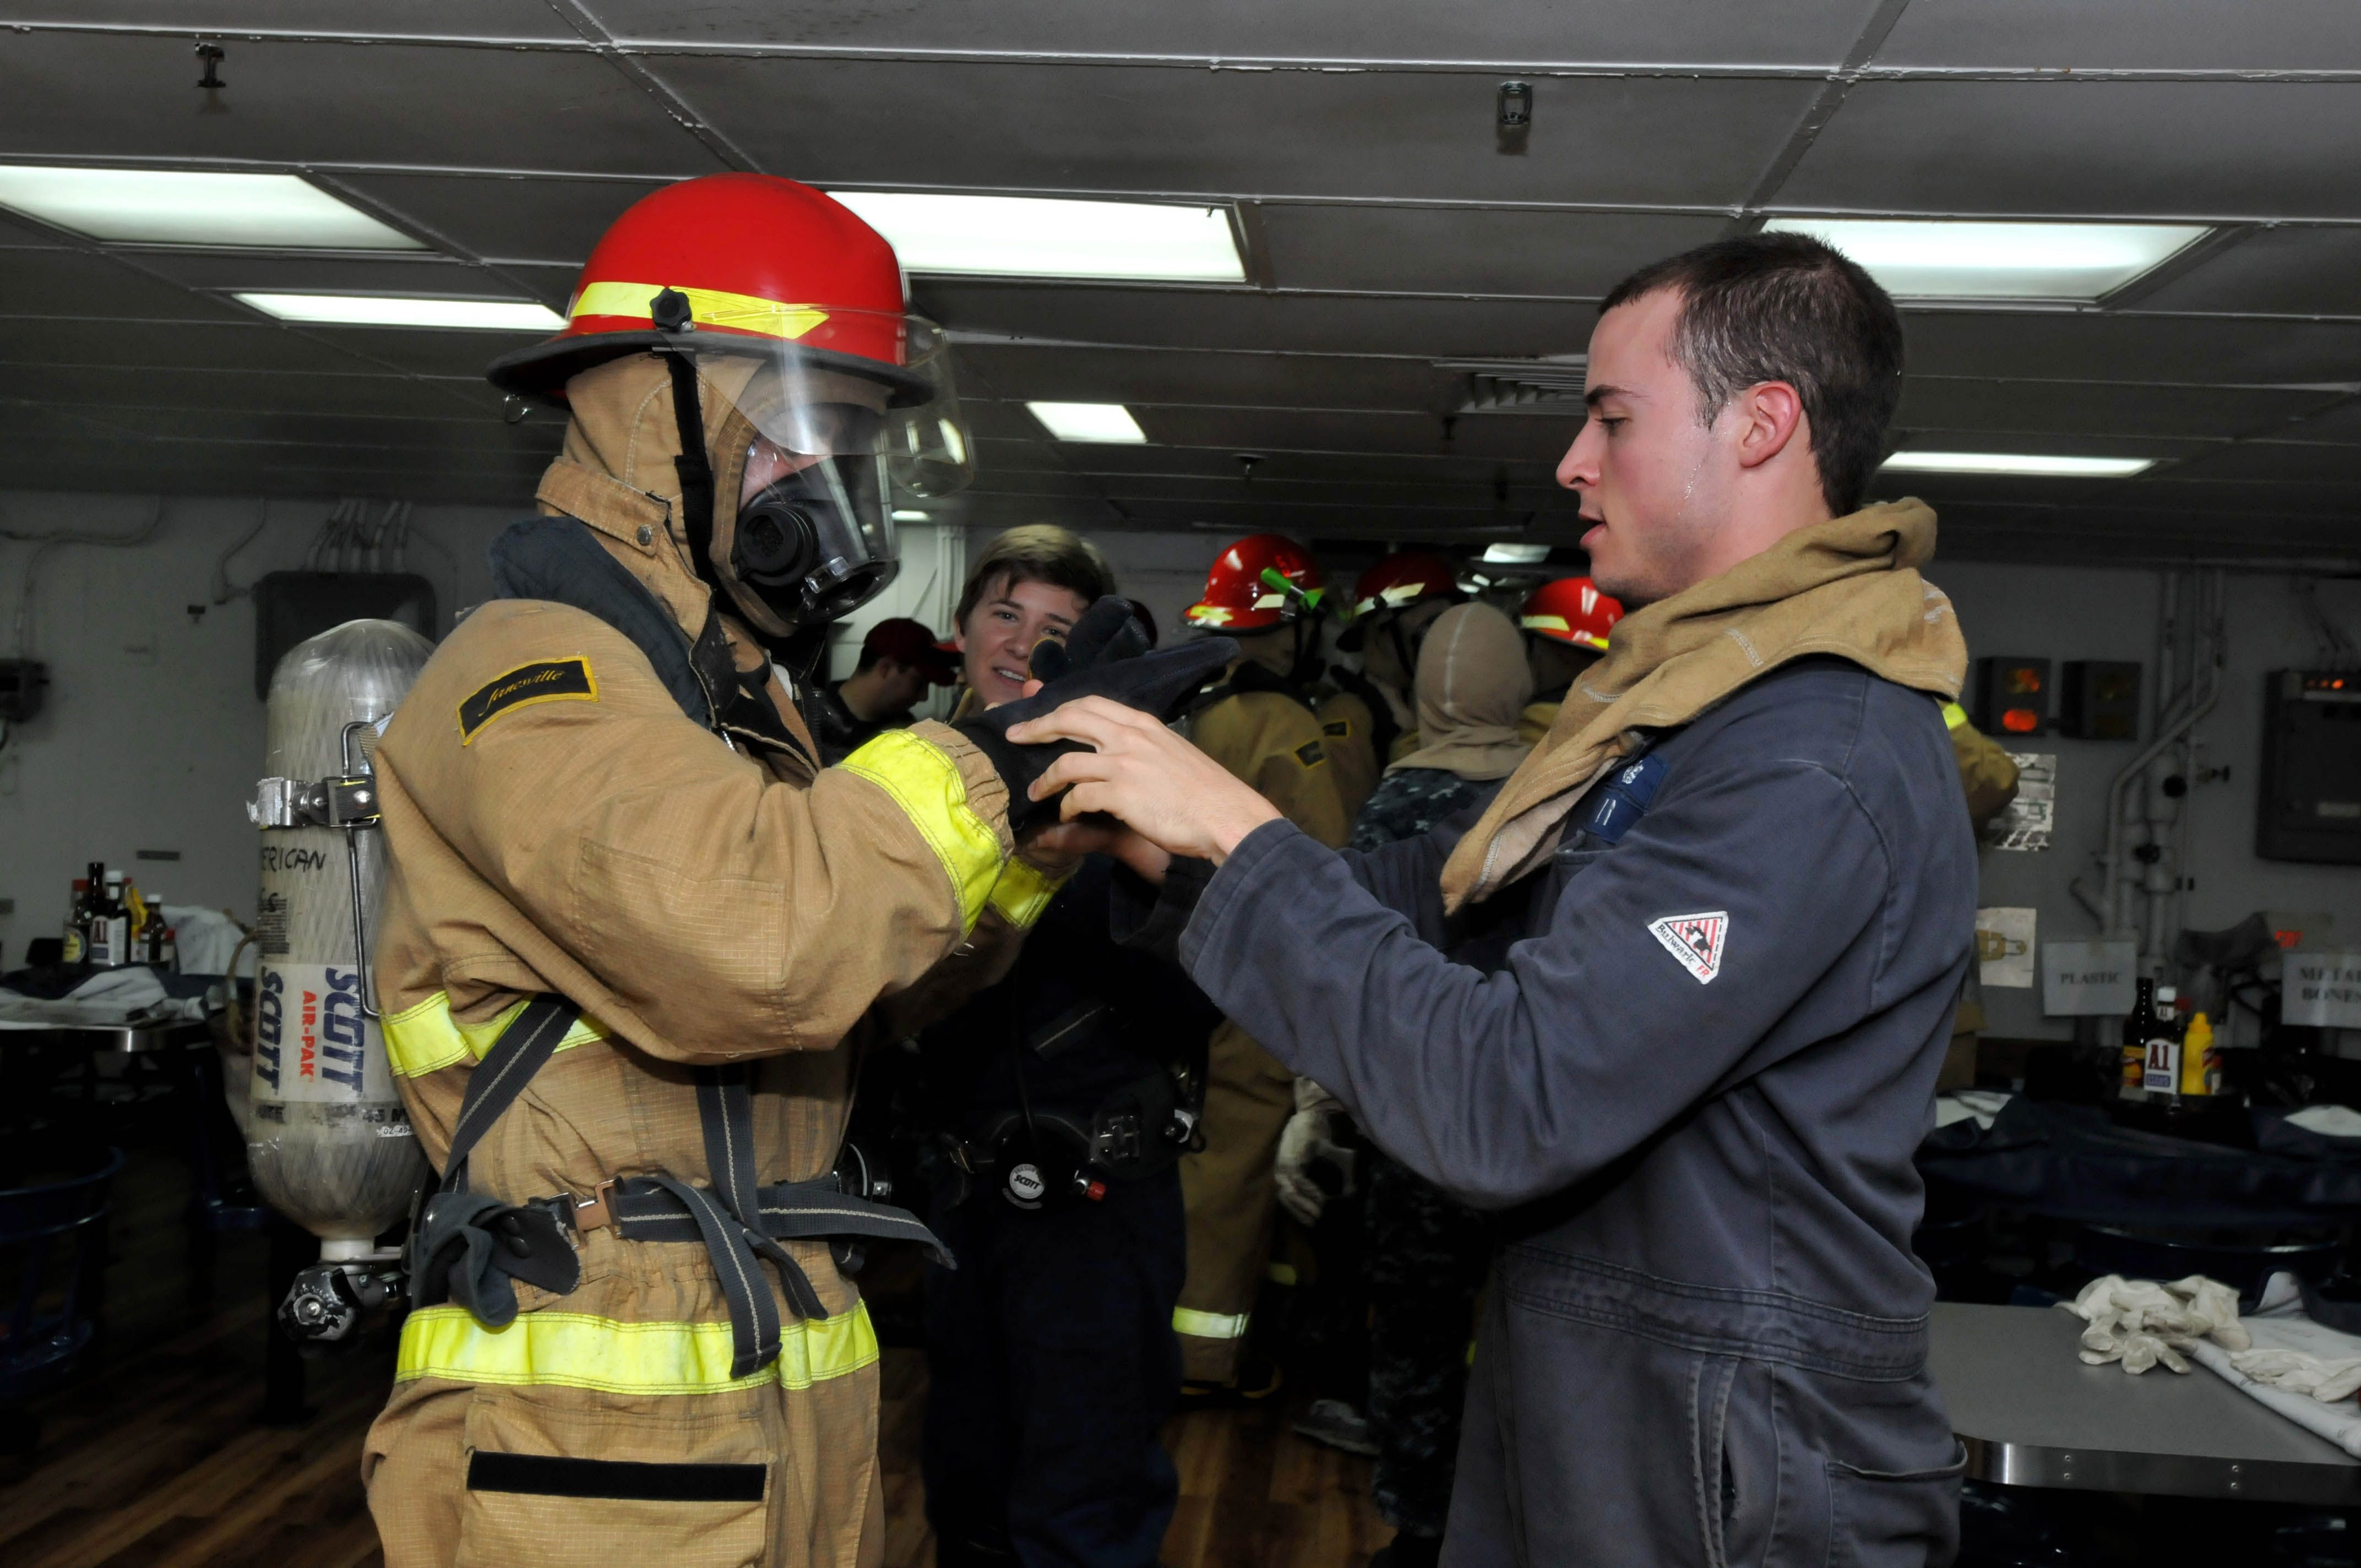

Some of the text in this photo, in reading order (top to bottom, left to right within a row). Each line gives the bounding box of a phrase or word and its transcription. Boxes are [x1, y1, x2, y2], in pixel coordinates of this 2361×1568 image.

[478, 669, 565, 717] Janesville
[2060, 971, 2119, 984] PLASTIC
[257, 966, 284, 1095] SCOTT
[322, 967, 365, 1093] SCOTT
[1014, 1174, 1041, 1190] SCOTT
